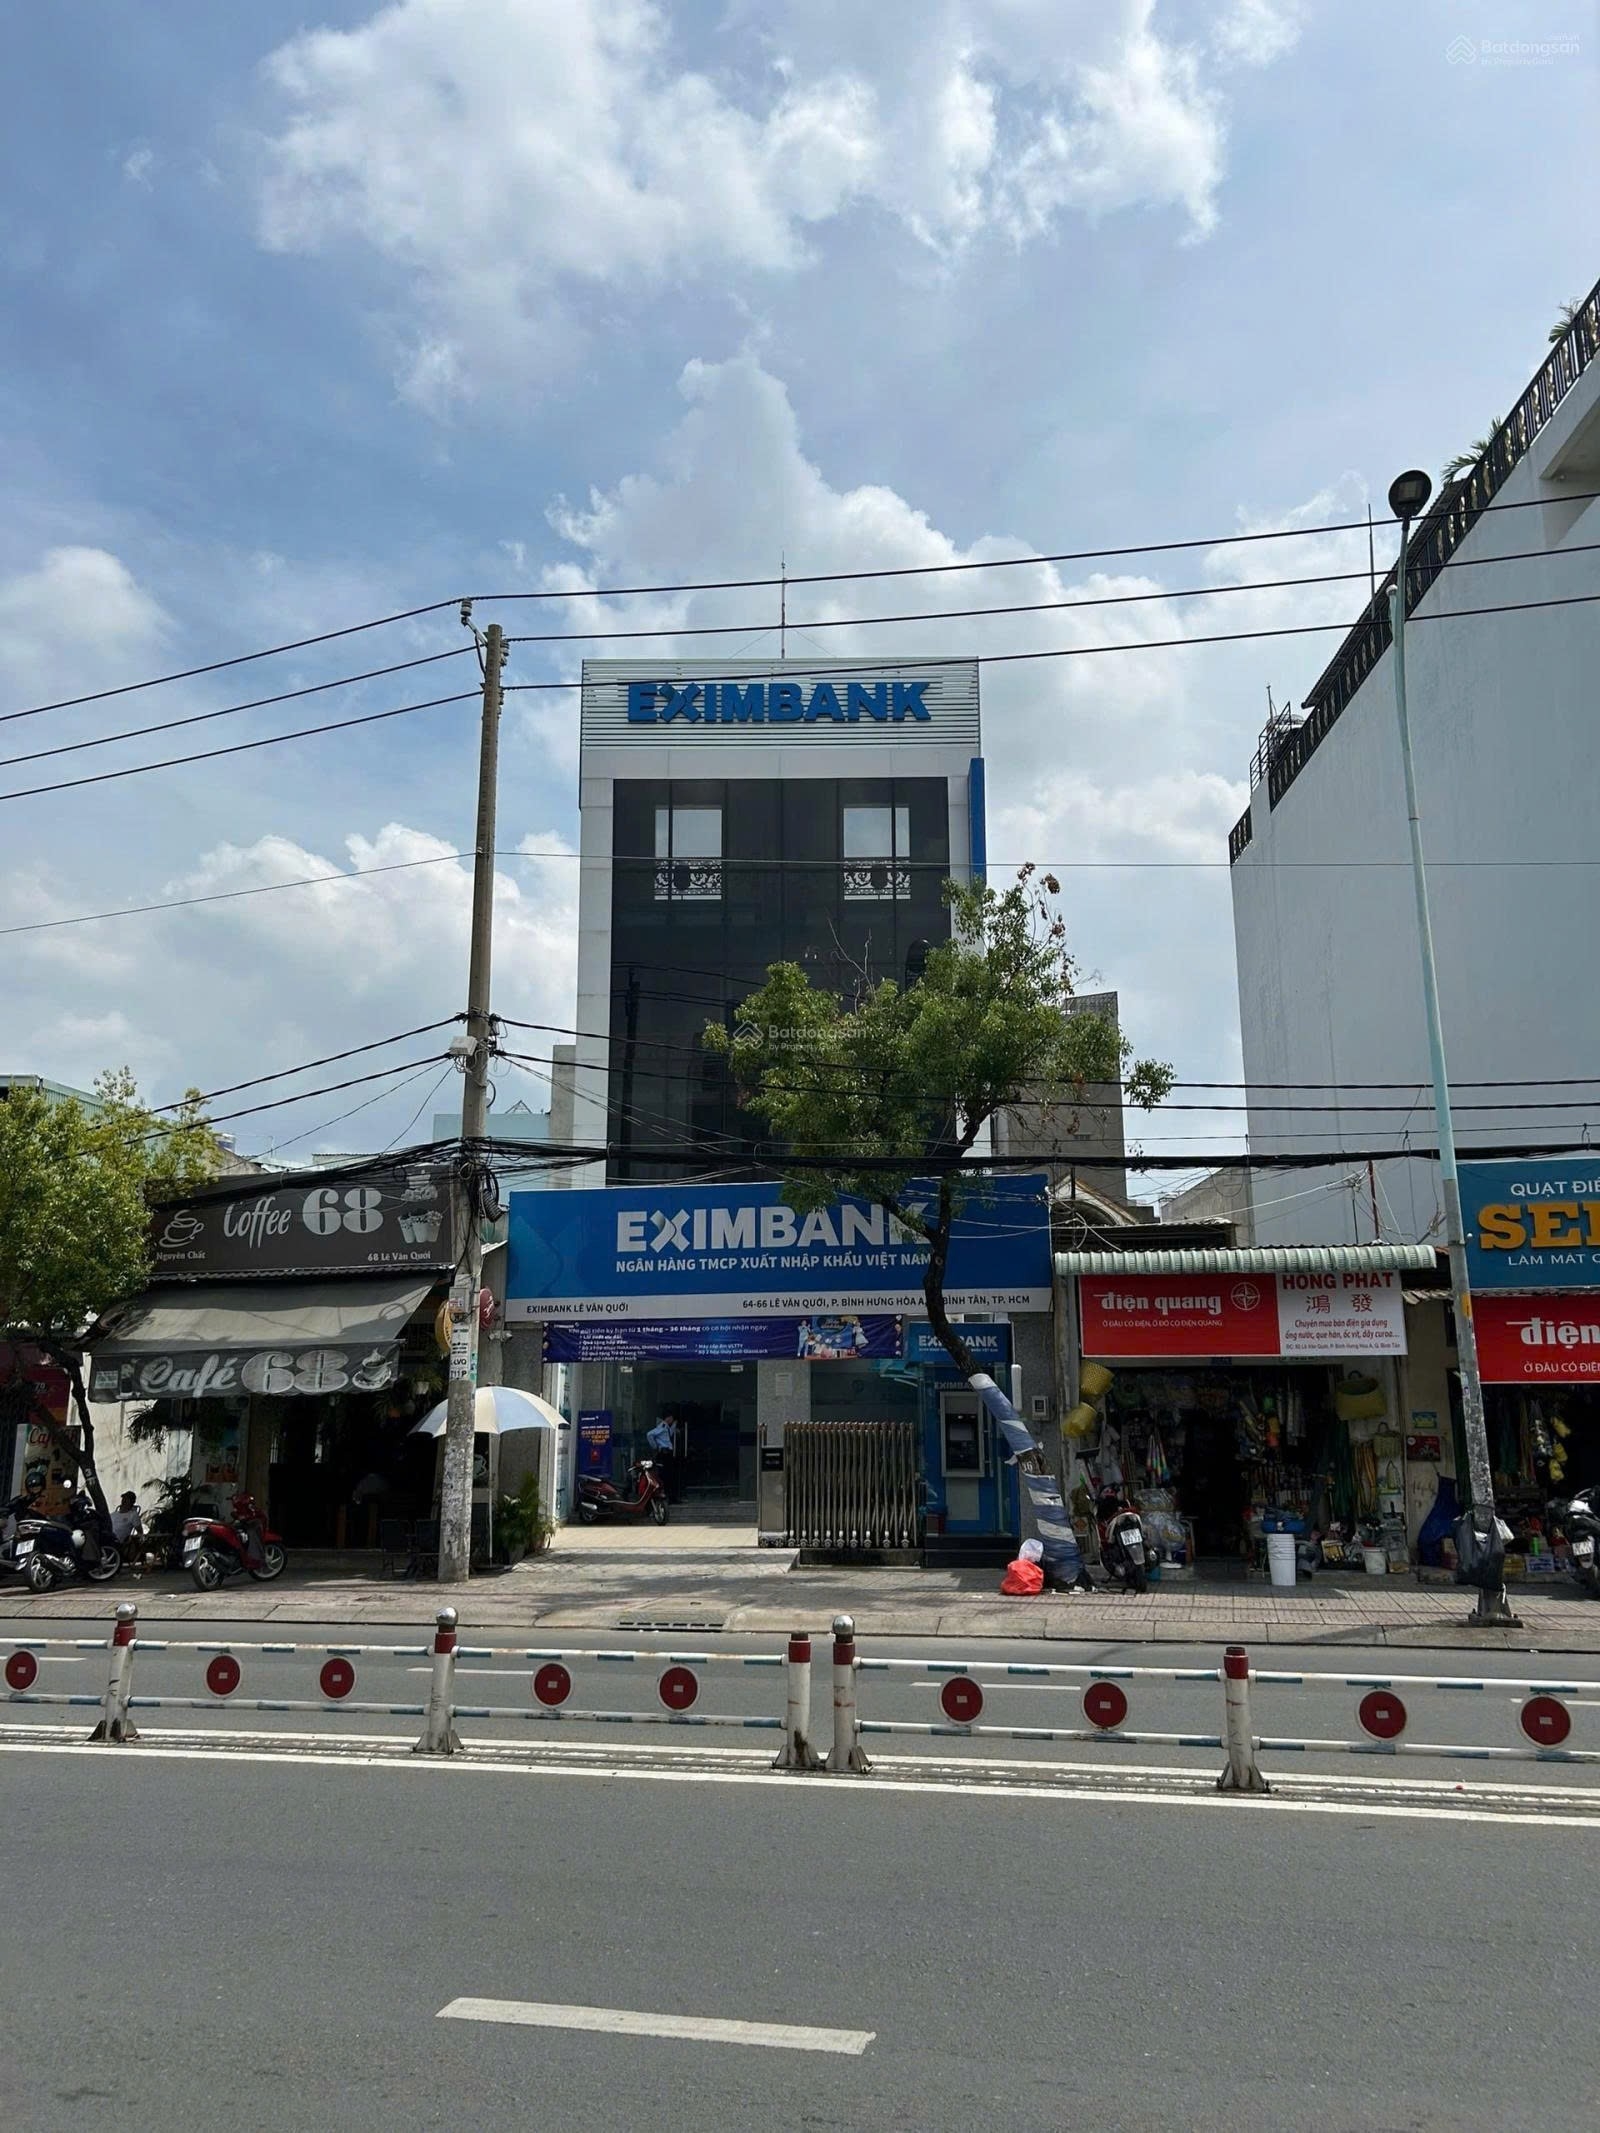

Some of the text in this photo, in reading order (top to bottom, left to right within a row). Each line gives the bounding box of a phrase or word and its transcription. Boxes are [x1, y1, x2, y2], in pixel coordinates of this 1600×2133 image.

[628, 682, 931, 723] EXIMBANK
[1510, 1181, 1568, 1198] QUẠT
[223, 1187, 384, 1248] Coffee 68
[616, 1202, 934, 1253] EXIMBANK
[367, 1253, 379, 1261] 68
[616, 1251, 931, 1272] NGÂN HÀNG TMCP XUẤT NHẬP KHẨU VIỆT NAM
[526, 1304, 572, 1313] EXIMBANK
[573, 1302, 584, 1312] LÊ
[586, 1302, 604, 1312] VĂN
[742, 1300, 768, 1308] 64-66
[769, 1297, 780, 1307] LÊ
[782, 1298, 800, 1307] VĂN
[831, 1299, 839, 1307] P.
[841, 1296, 864, 1306] BÌNH
[866, 1296, 894, 1306] HƯNG
[968, 1294, 990, 1306] TÂN,
[991, 1295, 1005, 1304] TP.
[1008, 1295, 1030, 1304] HCM
[1093, 1292, 1222, 1315] điện quang
[918, 1335, 998, 1347] EXANK
[139, 1350, 350, 1398] Café 68
[1524, 1361, 1600, 1373] Ở ĐÂU CÓ ĐIỆ
